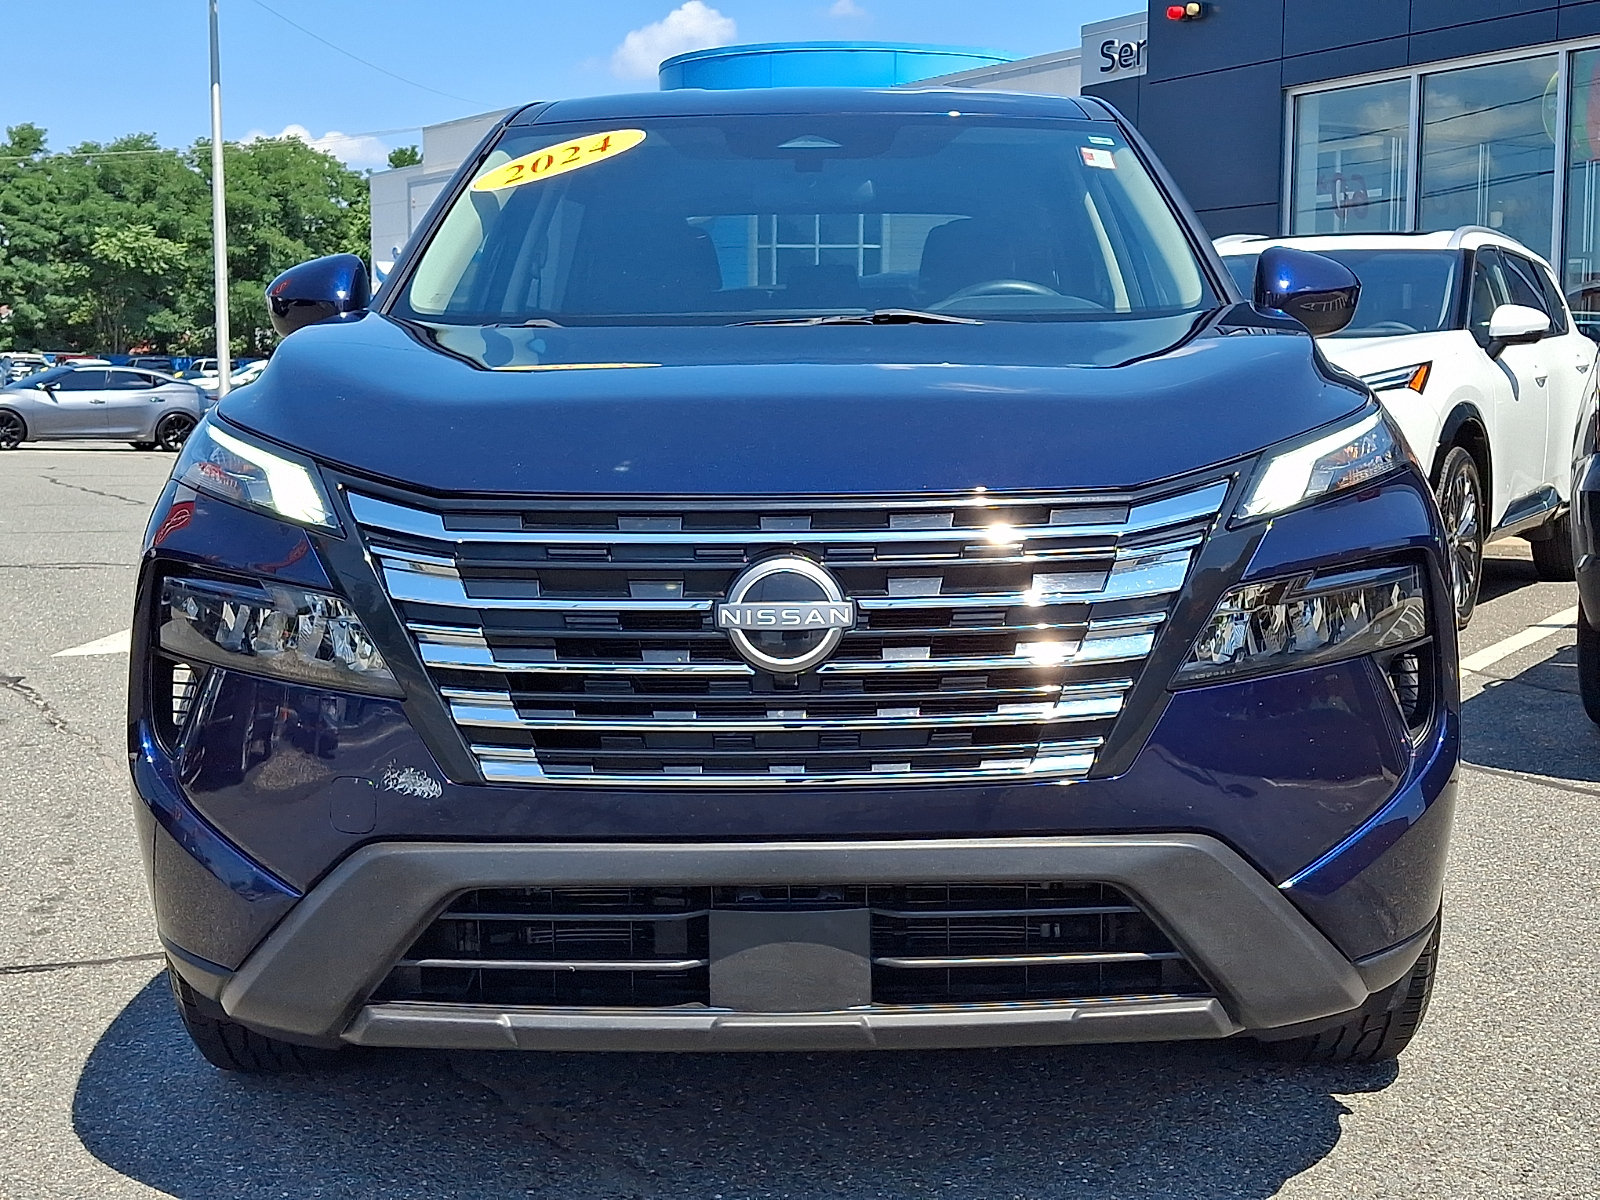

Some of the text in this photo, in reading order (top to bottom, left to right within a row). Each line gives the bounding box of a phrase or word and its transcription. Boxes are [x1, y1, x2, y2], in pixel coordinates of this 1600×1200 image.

[1100, 39, 1147, 73] Ser
[504, 135, 612, 185] 2024
[720, 607, 850, 626] NISSAN
